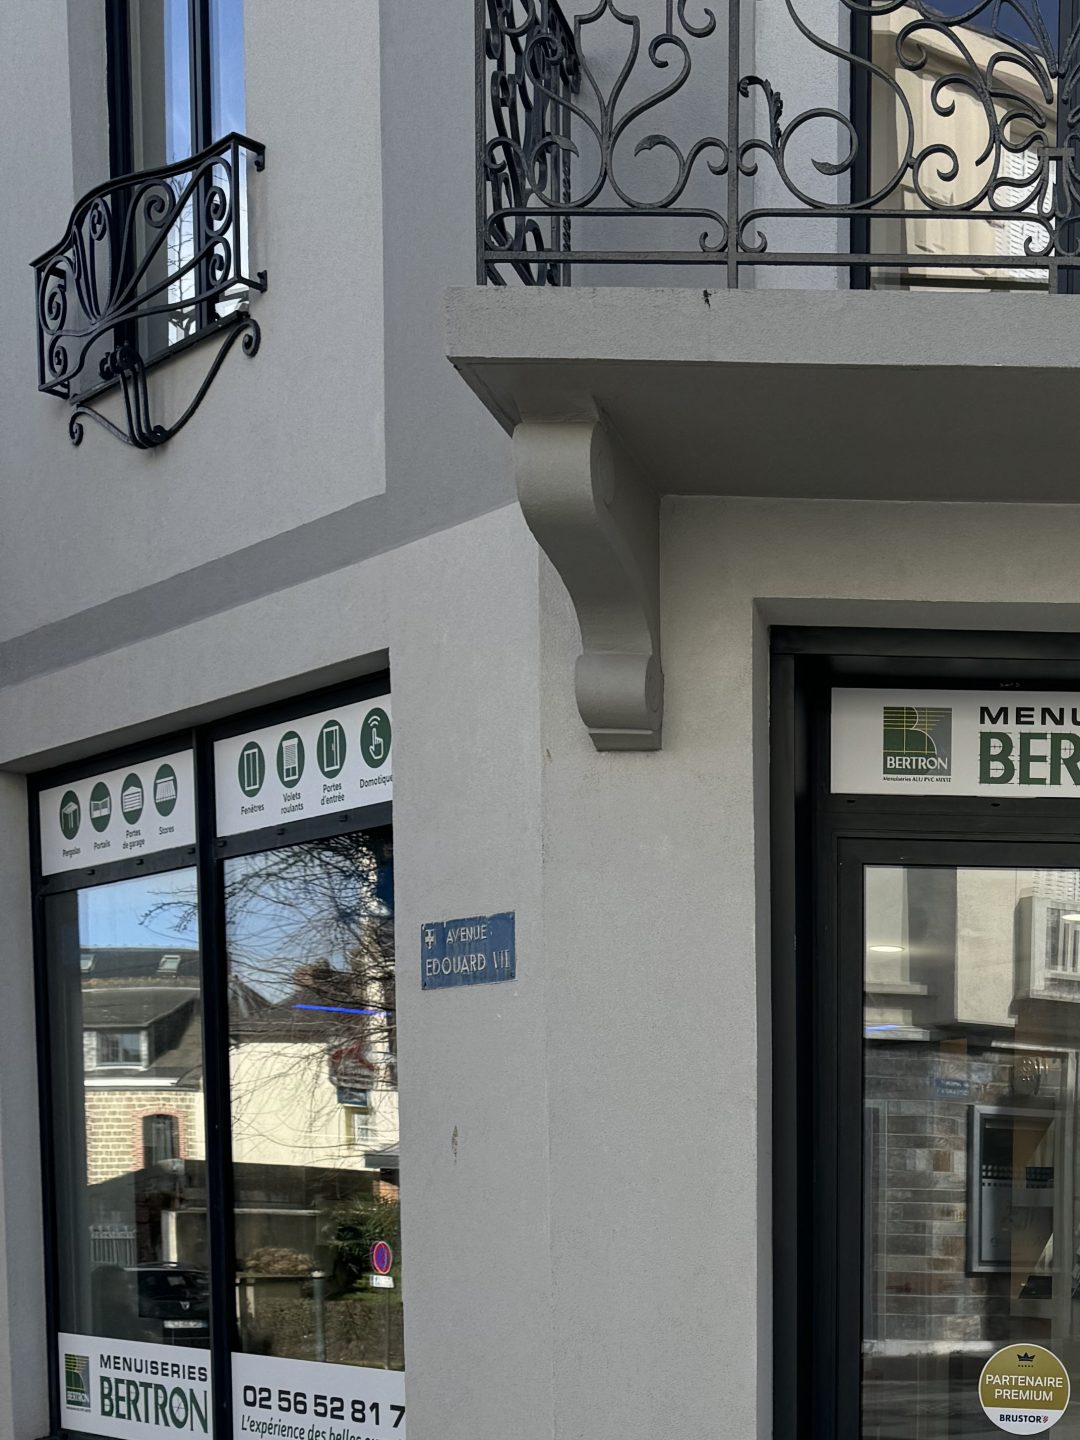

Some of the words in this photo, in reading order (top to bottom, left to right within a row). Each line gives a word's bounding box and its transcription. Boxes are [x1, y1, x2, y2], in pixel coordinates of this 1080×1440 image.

[886, 756, 948, 770] BERTRON
[322, 782, 342, 794] Portes
[282, 792, 301, 803] Volets
[320, 792, 345, 806] d'entrée
[240, 803, 265, 816] Fenêtres
[280, 802, 304, 815] roulants
[125, 829, 142, 839] Portes
[158, 826, 175, 836] Stores
[446, 924, 488, 944] AVENUE
[426, 953, 486, 977] EDOUARD
[99, 1353, 208, 1382] MENUISERIES
[985, 1374, 1064, 1388] PARTENAIRE
[994, 1388, 1053, 1401] PREMIUM
[99, 1374, 208, 1434] BERTRON
[243, 1385, 272, 1410] 02
[278, 1389, 308, 1415] 56
[313, 1394, 345, 1420] 52
[351, 1399, 380, 1426] 81
[999, 1414, 1042, 1423] BRUSTOR
[241, 1415, 305, 1440] L'expérience
